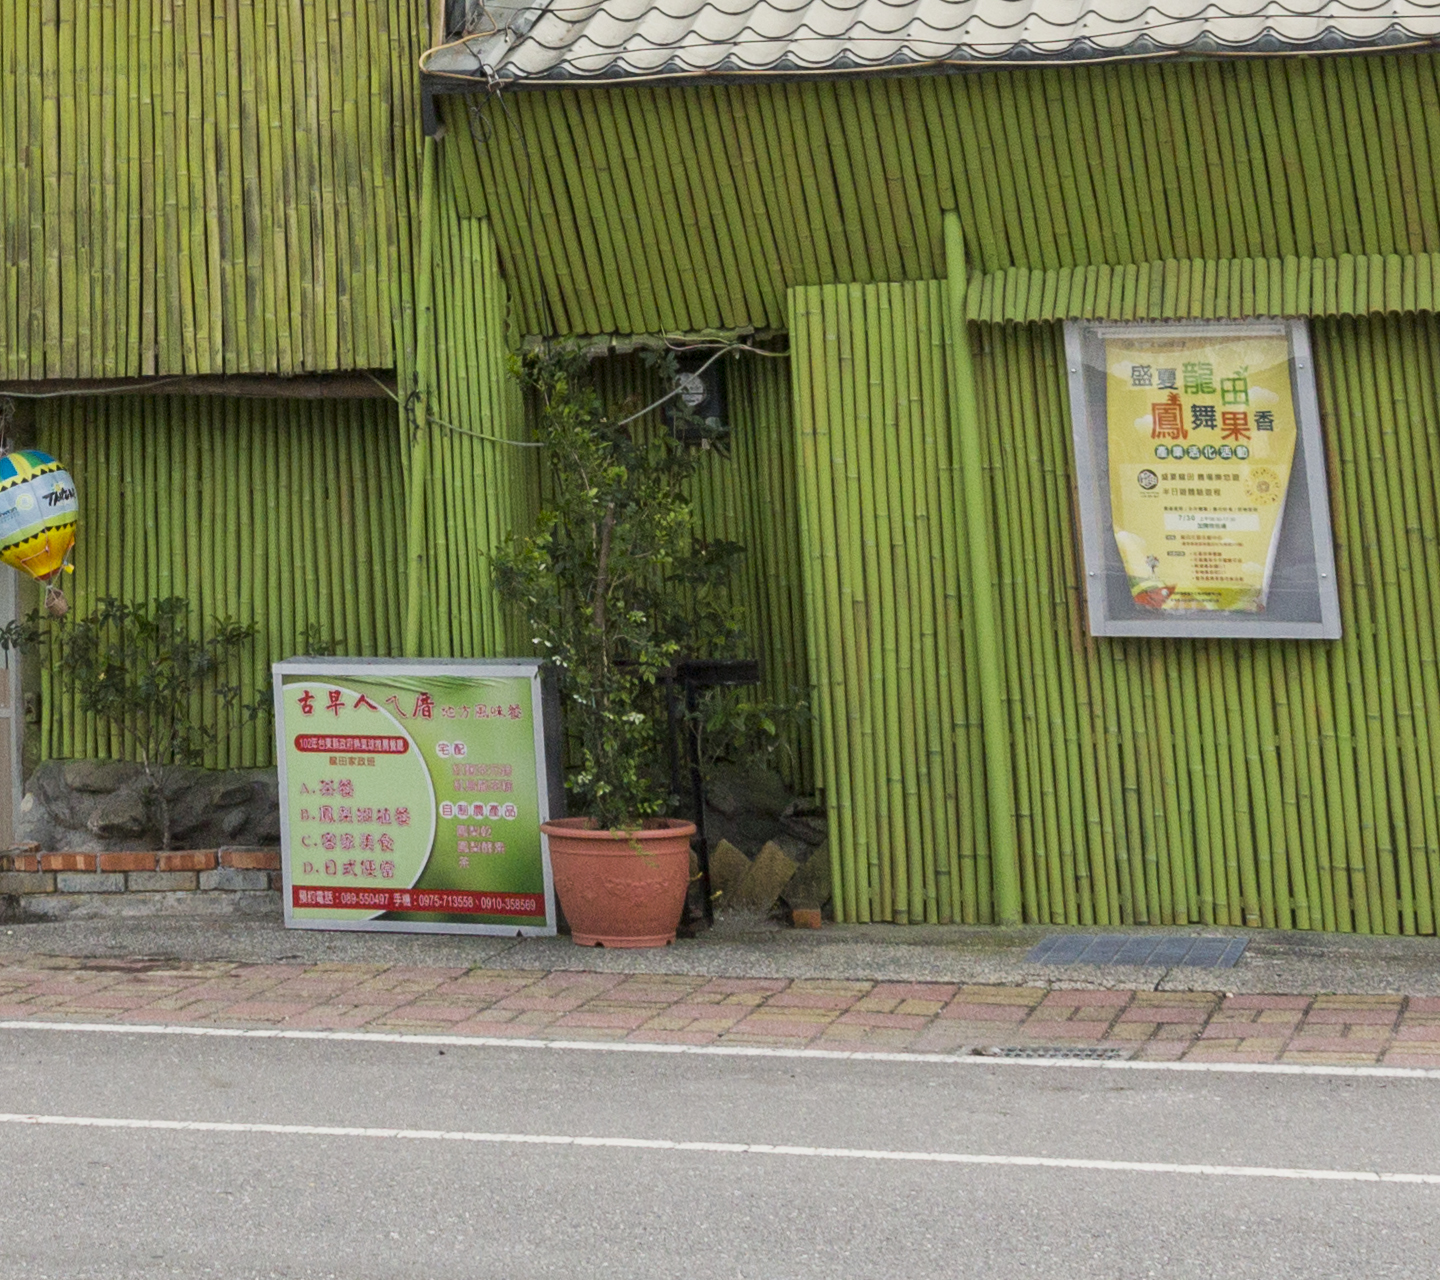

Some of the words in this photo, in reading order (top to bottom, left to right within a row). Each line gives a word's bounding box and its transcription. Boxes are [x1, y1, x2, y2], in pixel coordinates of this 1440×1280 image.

[1130, 361, 1250, 407] 盛夏龍田
[1150, 392, 1275, 441] 鳳舞果香
[437, 743, 466, 756] 宅配
